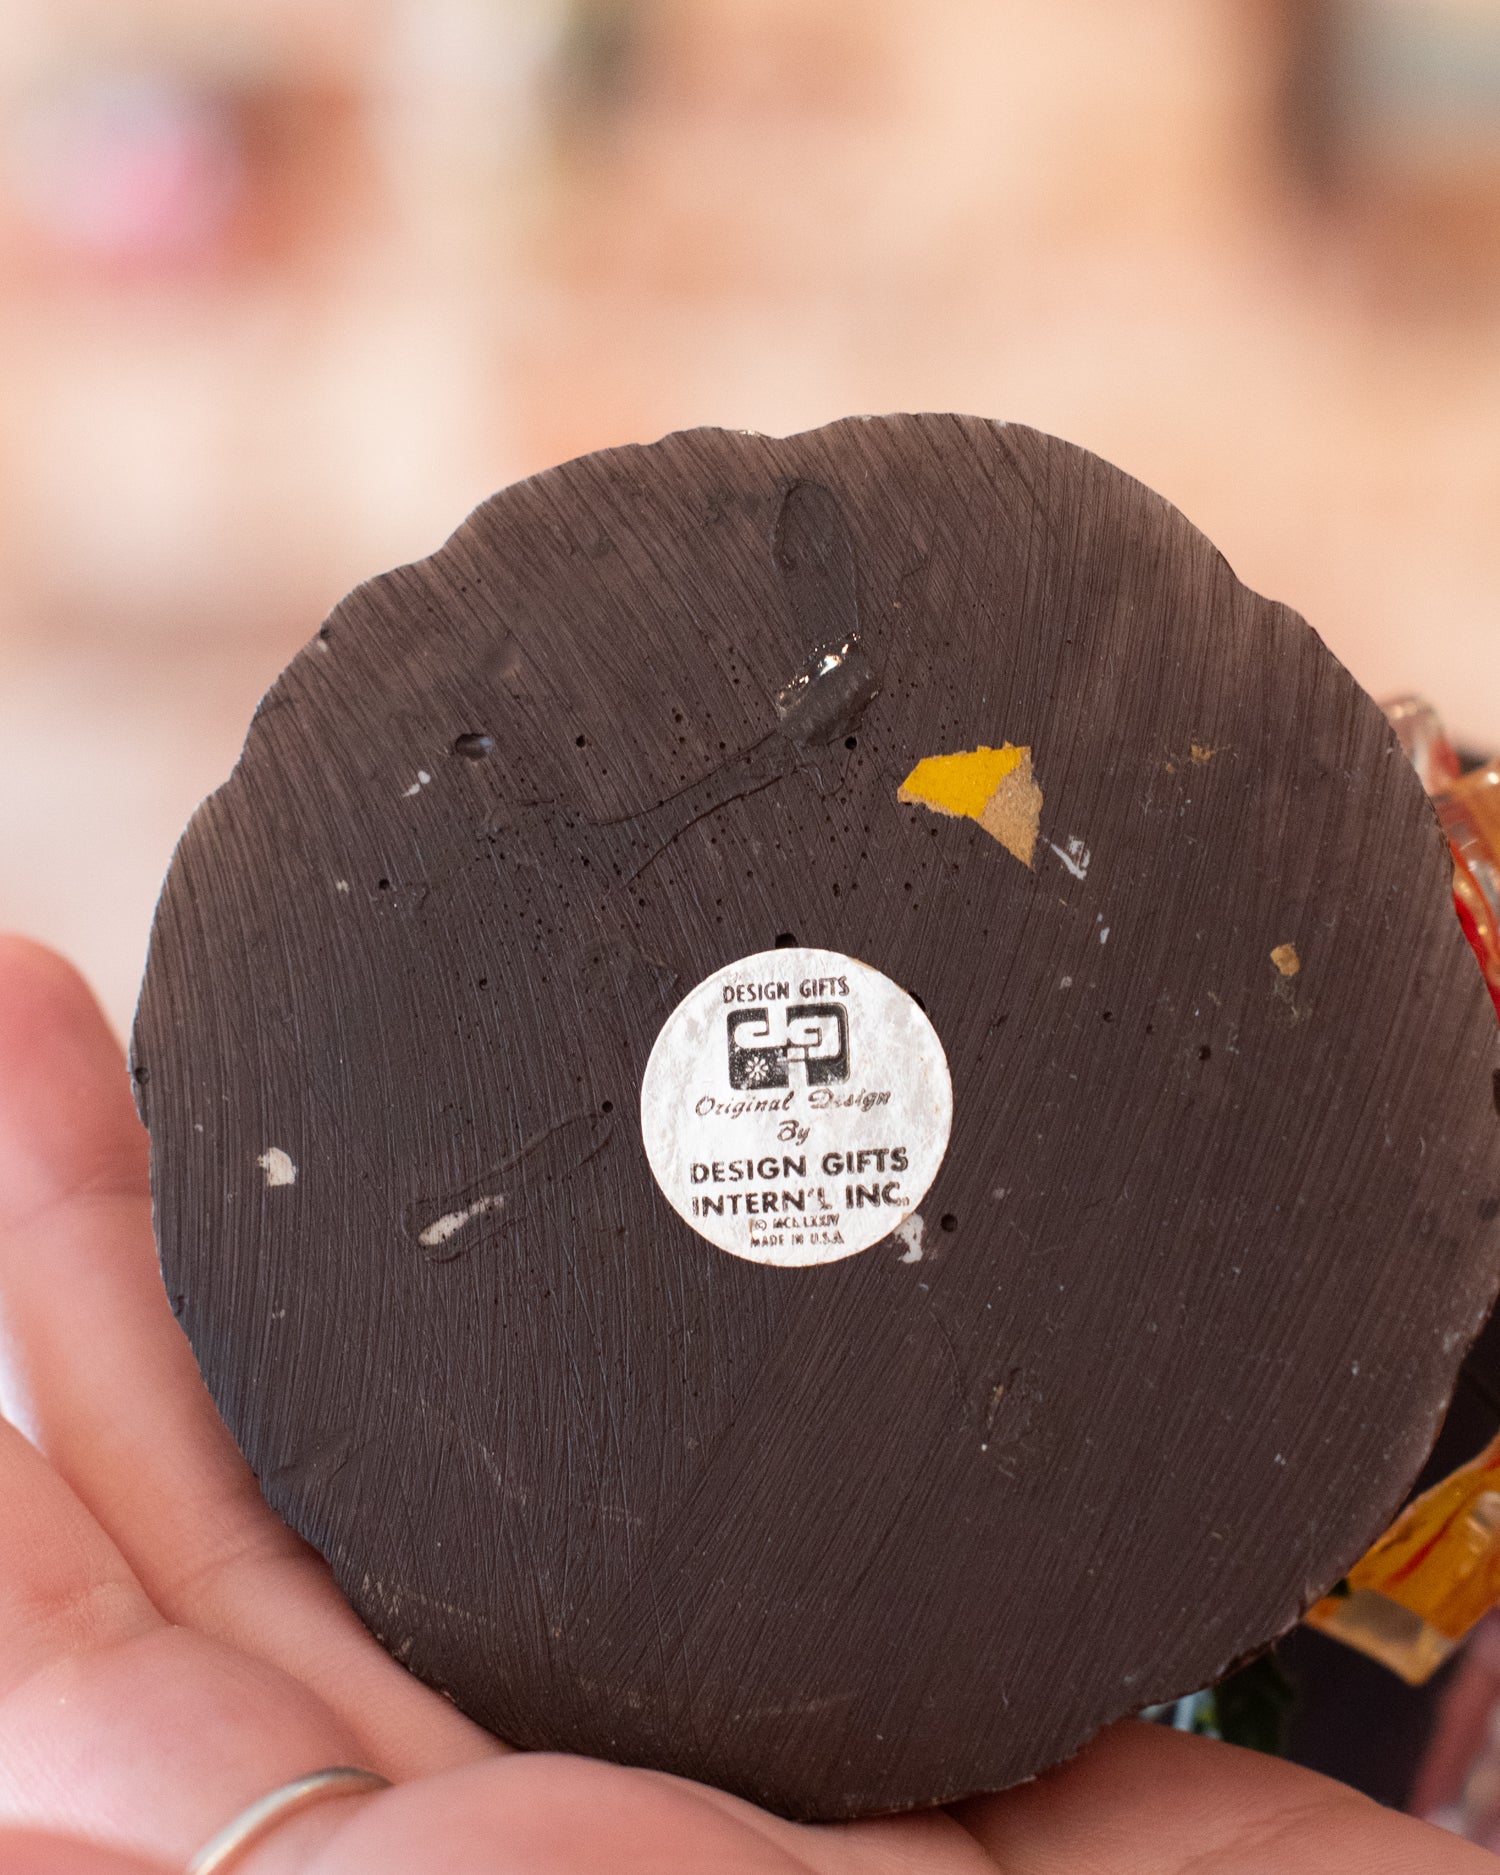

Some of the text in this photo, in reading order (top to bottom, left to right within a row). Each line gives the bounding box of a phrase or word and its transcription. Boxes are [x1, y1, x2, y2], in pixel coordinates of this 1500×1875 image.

[723, 976, 849, 1003] DESIGN GIFTS
[695, 1089, 891, 1119] Original Design
[777, 1120, 811, 1145] By
[691, 1147, 908, 1184] DESIGN GIFTS
[750, 1234, 784, 1247] MADE
[792, 1234, 803, 1245] IN
